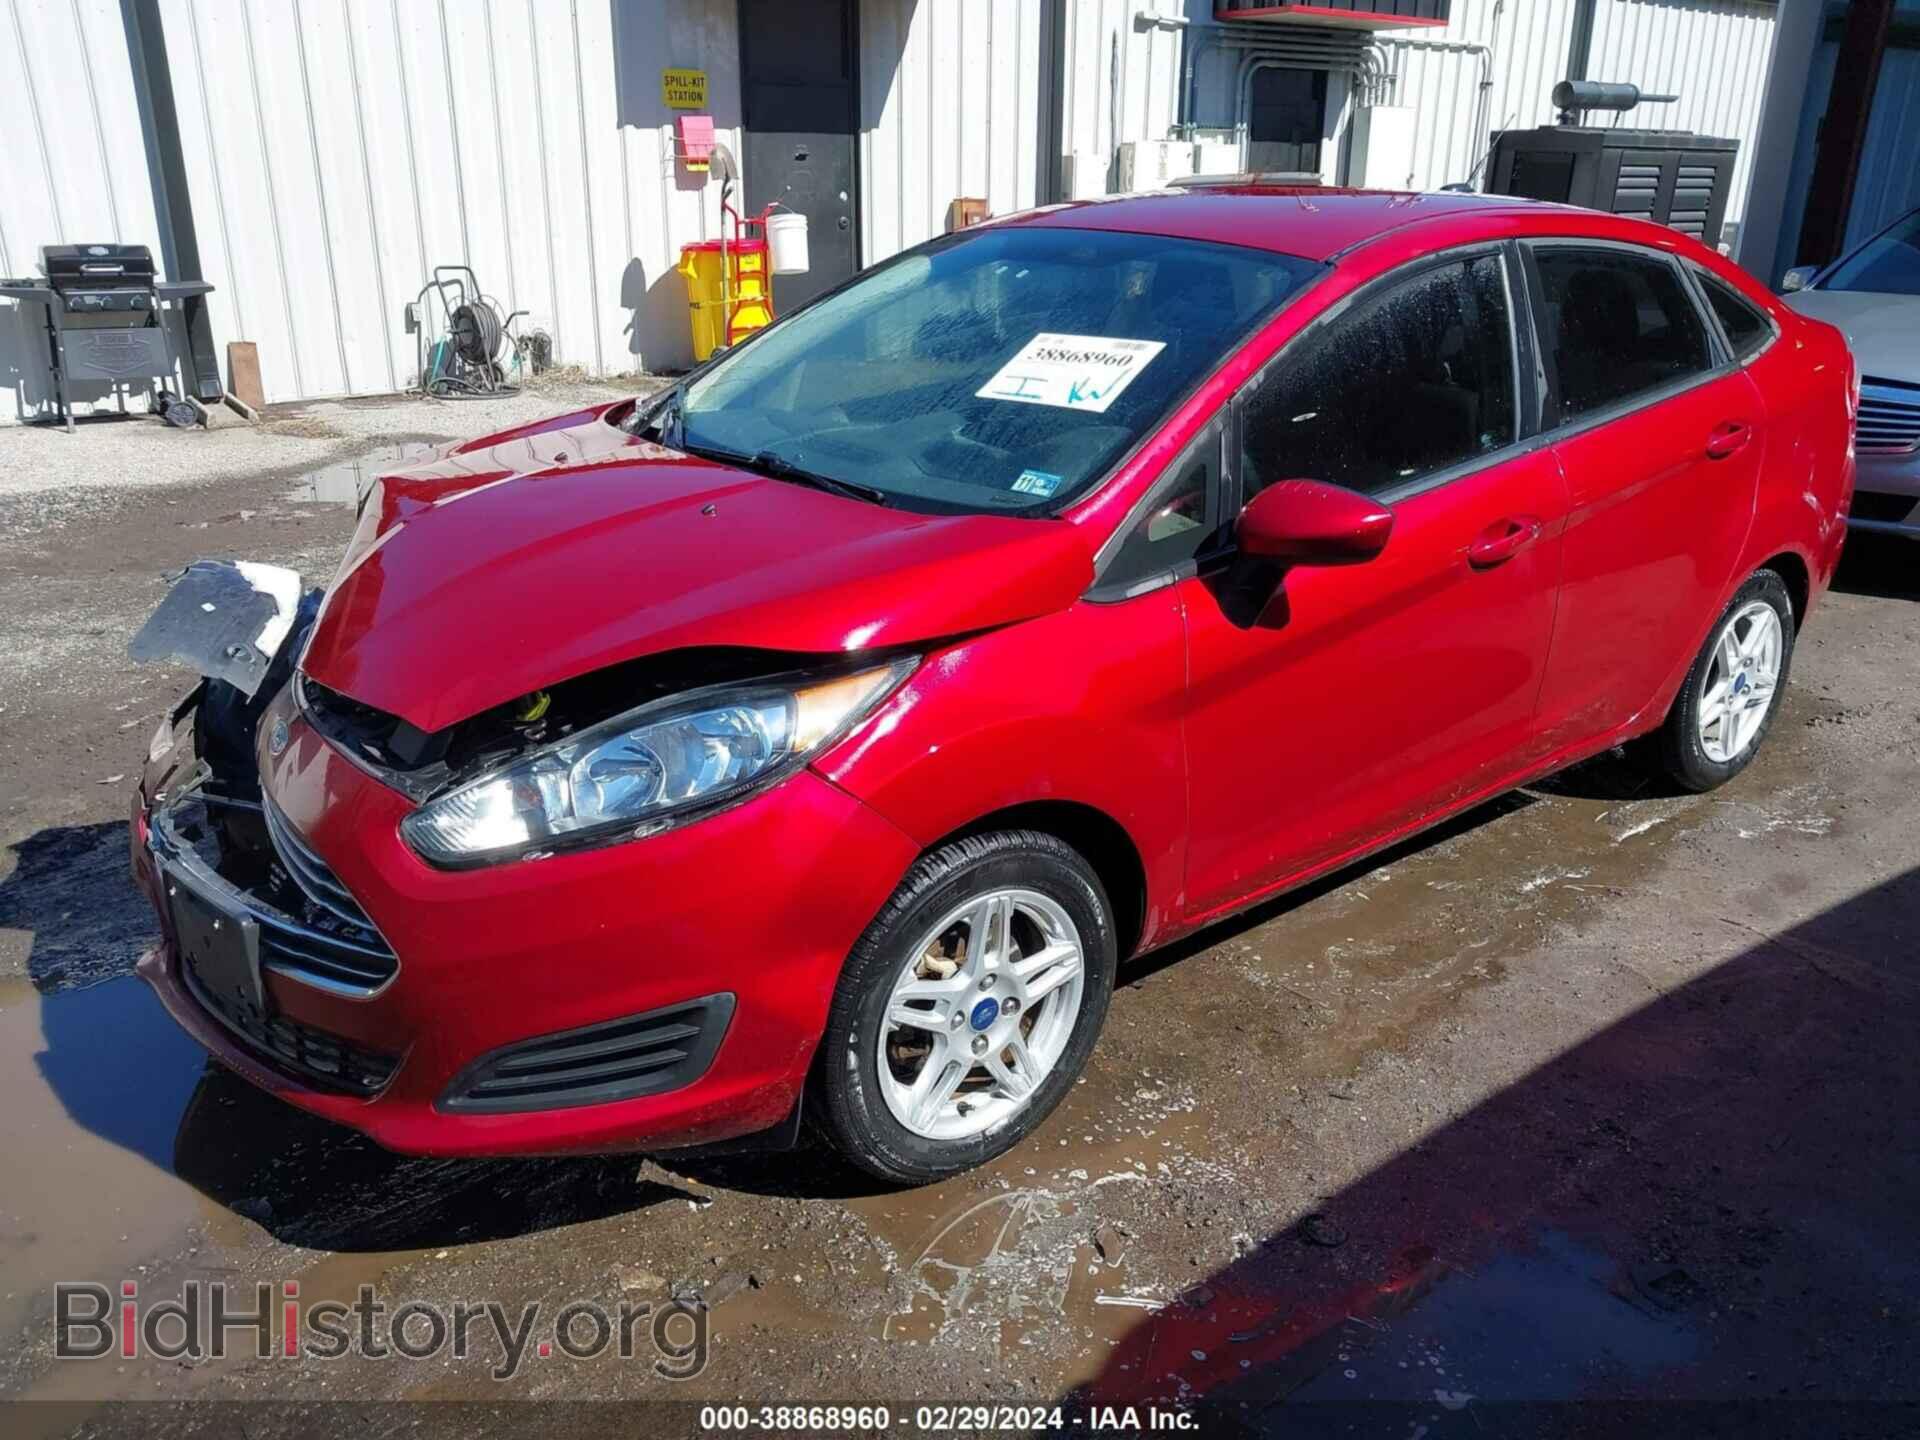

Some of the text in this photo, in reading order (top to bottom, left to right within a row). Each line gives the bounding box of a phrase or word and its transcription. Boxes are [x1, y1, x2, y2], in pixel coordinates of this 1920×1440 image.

[663, 75, 705, 88] SPILL-KIT
[667, 90, 703, 101] STATION
[1027, 347, 1134, 367] 38868960
